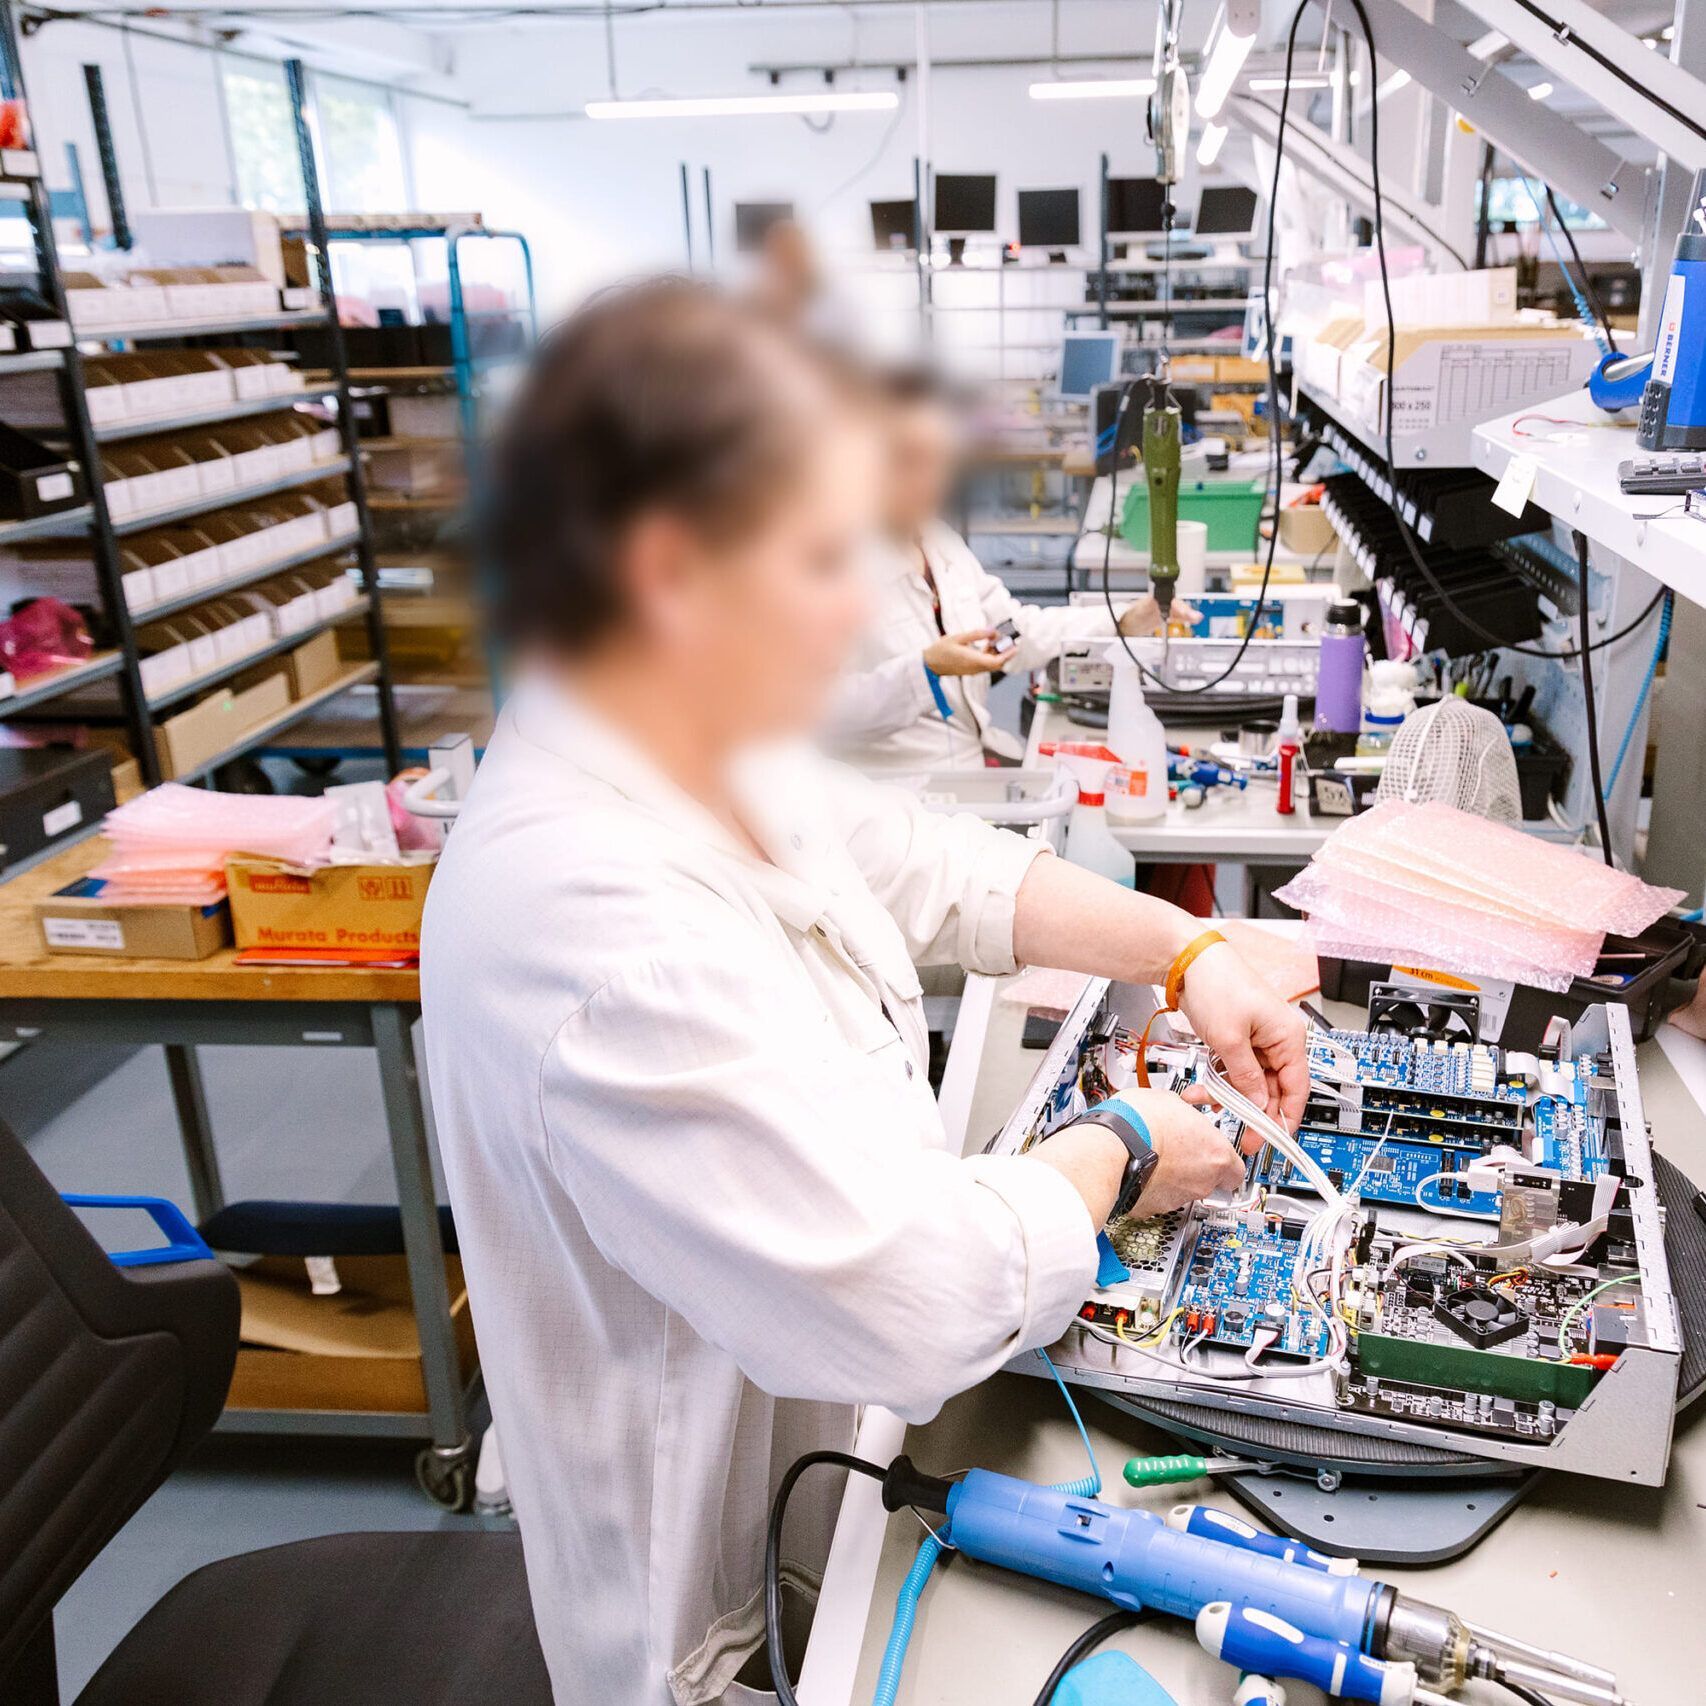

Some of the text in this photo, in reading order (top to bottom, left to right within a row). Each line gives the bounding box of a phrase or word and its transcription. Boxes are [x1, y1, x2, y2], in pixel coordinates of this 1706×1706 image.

[1661, 334, 1673, 376] BERNER
[258, 927, 419, 944] Murata Products
